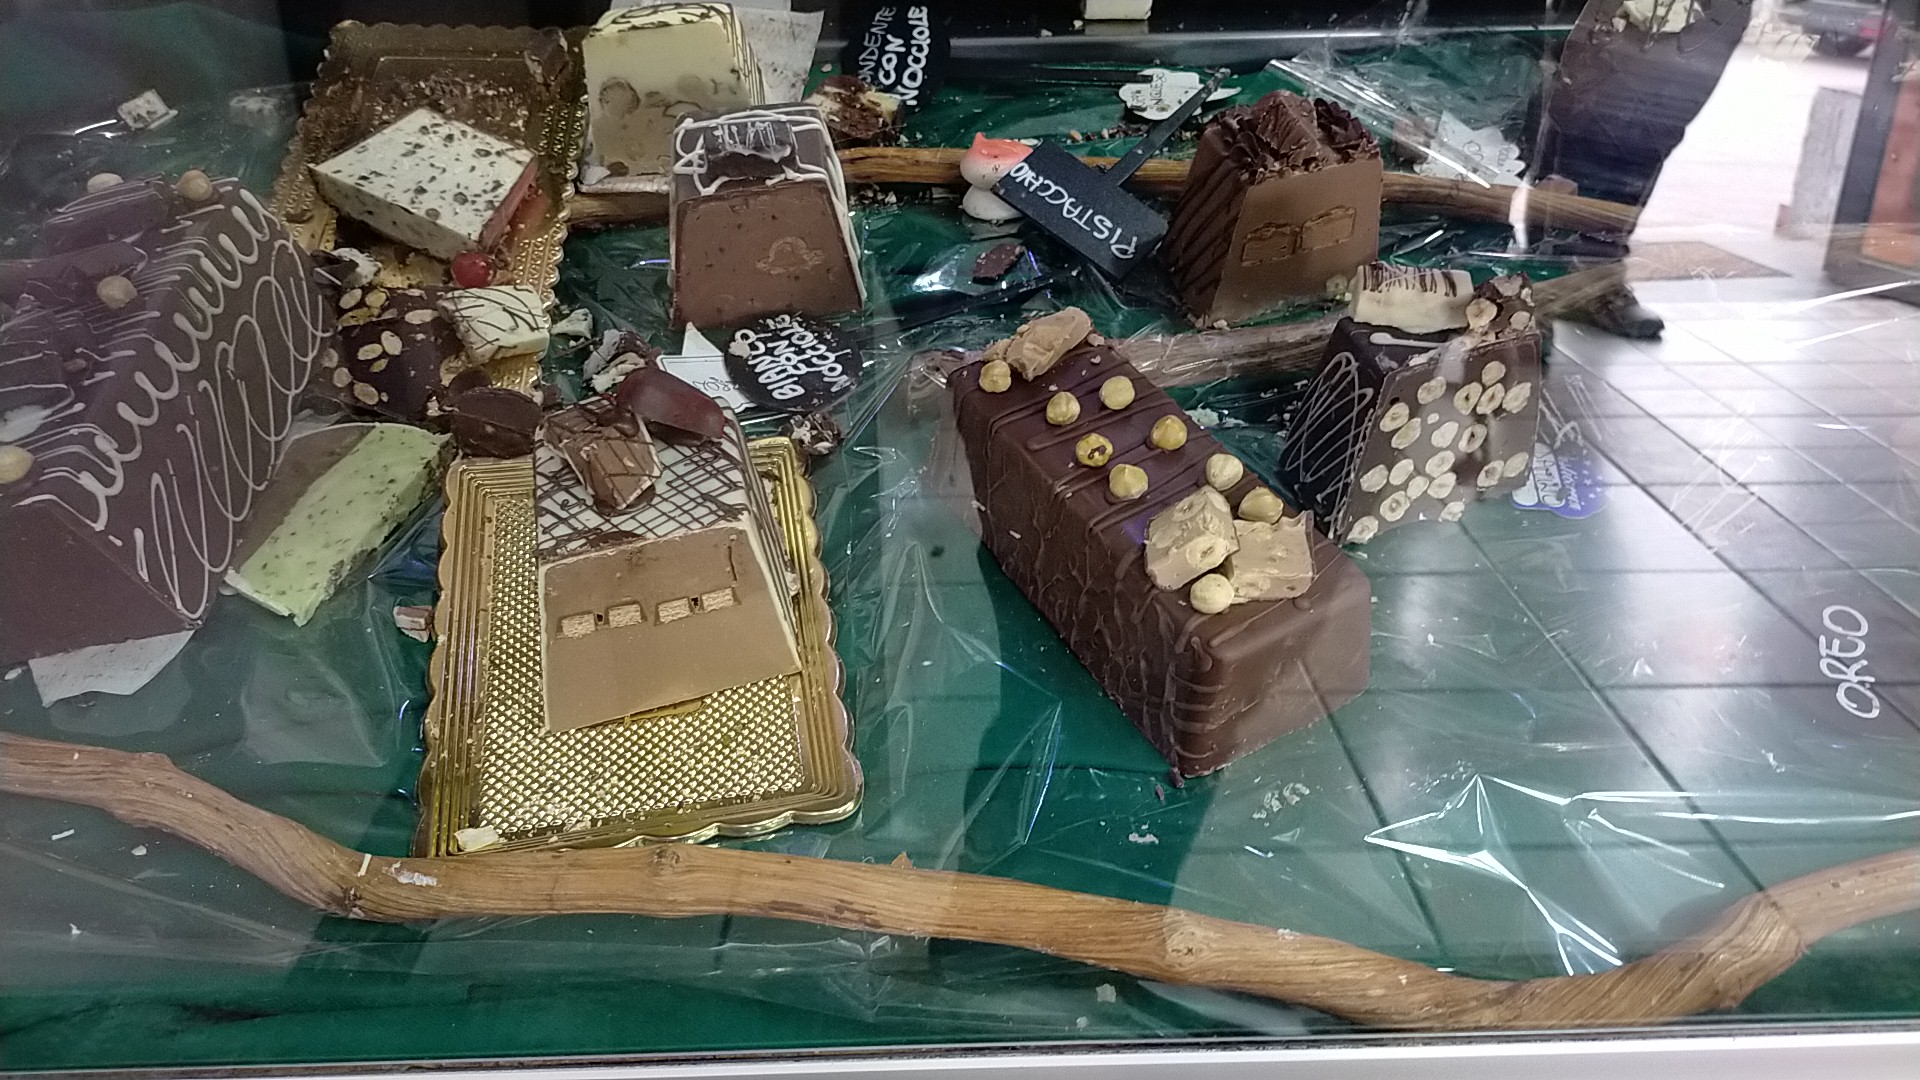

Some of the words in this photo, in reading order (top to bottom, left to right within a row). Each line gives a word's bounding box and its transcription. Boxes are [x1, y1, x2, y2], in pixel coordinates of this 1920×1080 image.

[878, 34, 906, 86] CON
[896, 5, 930, 106] NOCCIOLE
[734, 328, 805, 399] BIANCO
[767, 340, 826, 375] CON
[1818, 604, 1881, 719] OREO
